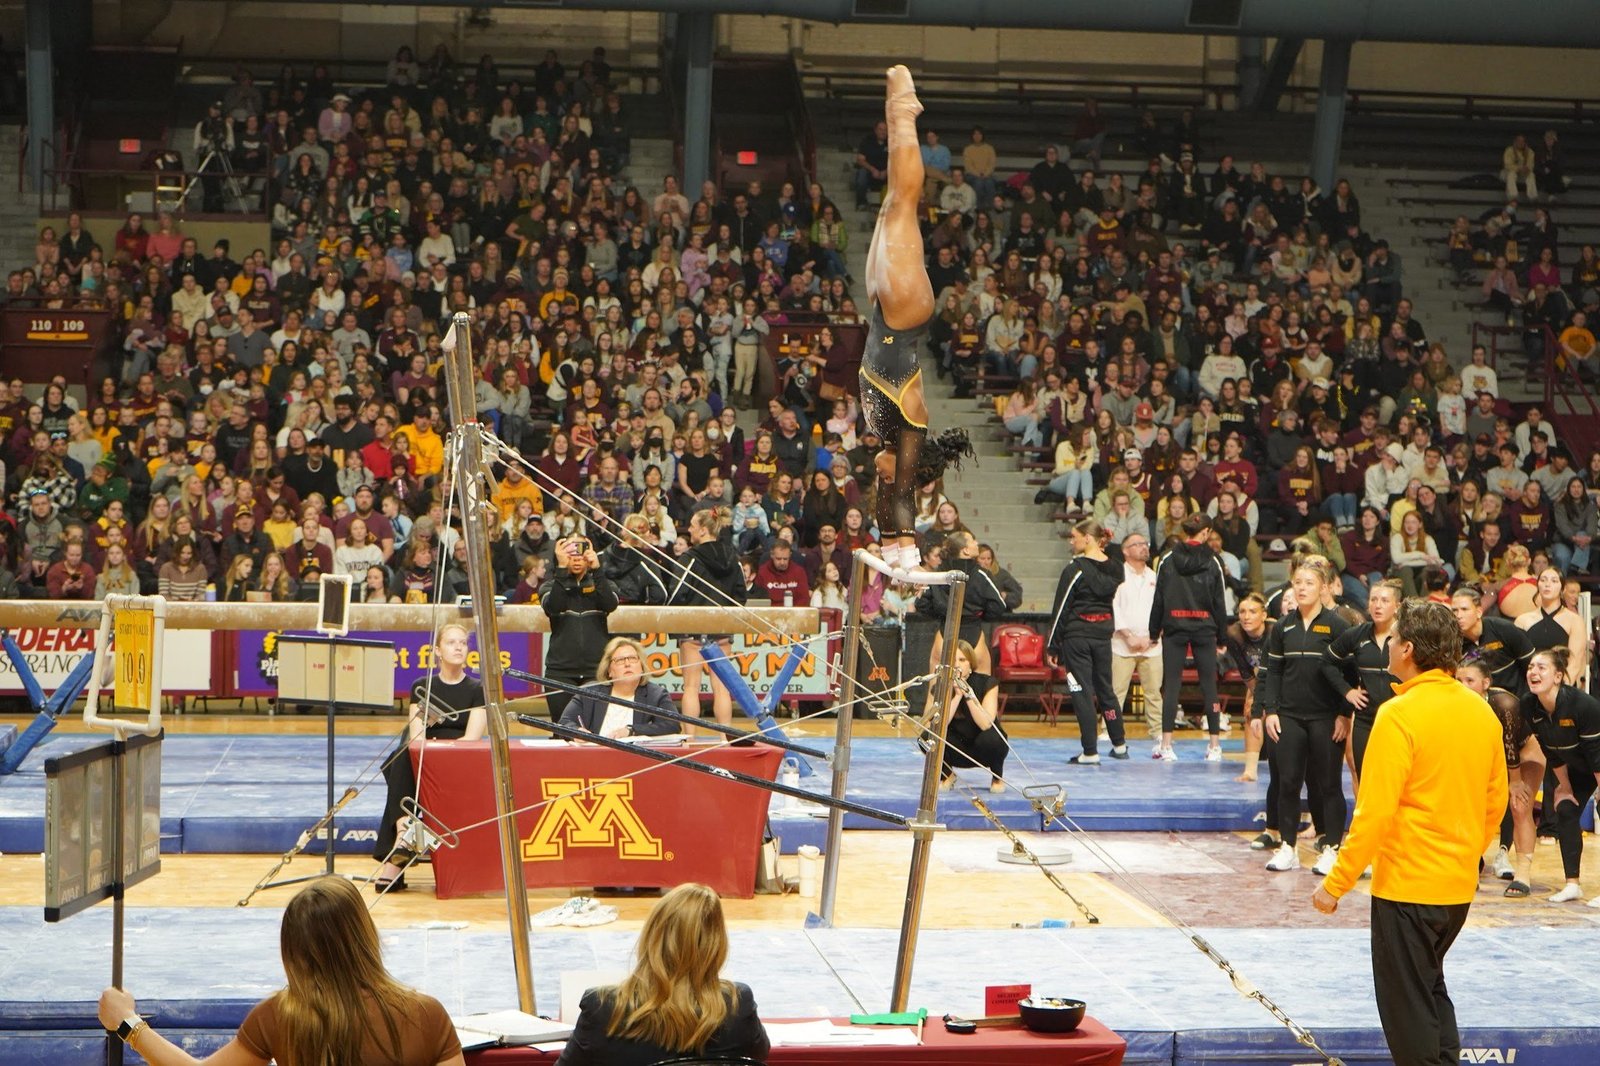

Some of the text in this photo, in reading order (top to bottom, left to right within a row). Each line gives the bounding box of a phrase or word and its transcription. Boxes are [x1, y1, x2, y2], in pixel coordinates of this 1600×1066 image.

[31, 319, 85, 332] 110 109
[122, 652, 146, 685] 10.0
[520, 778, 663, 862] M
